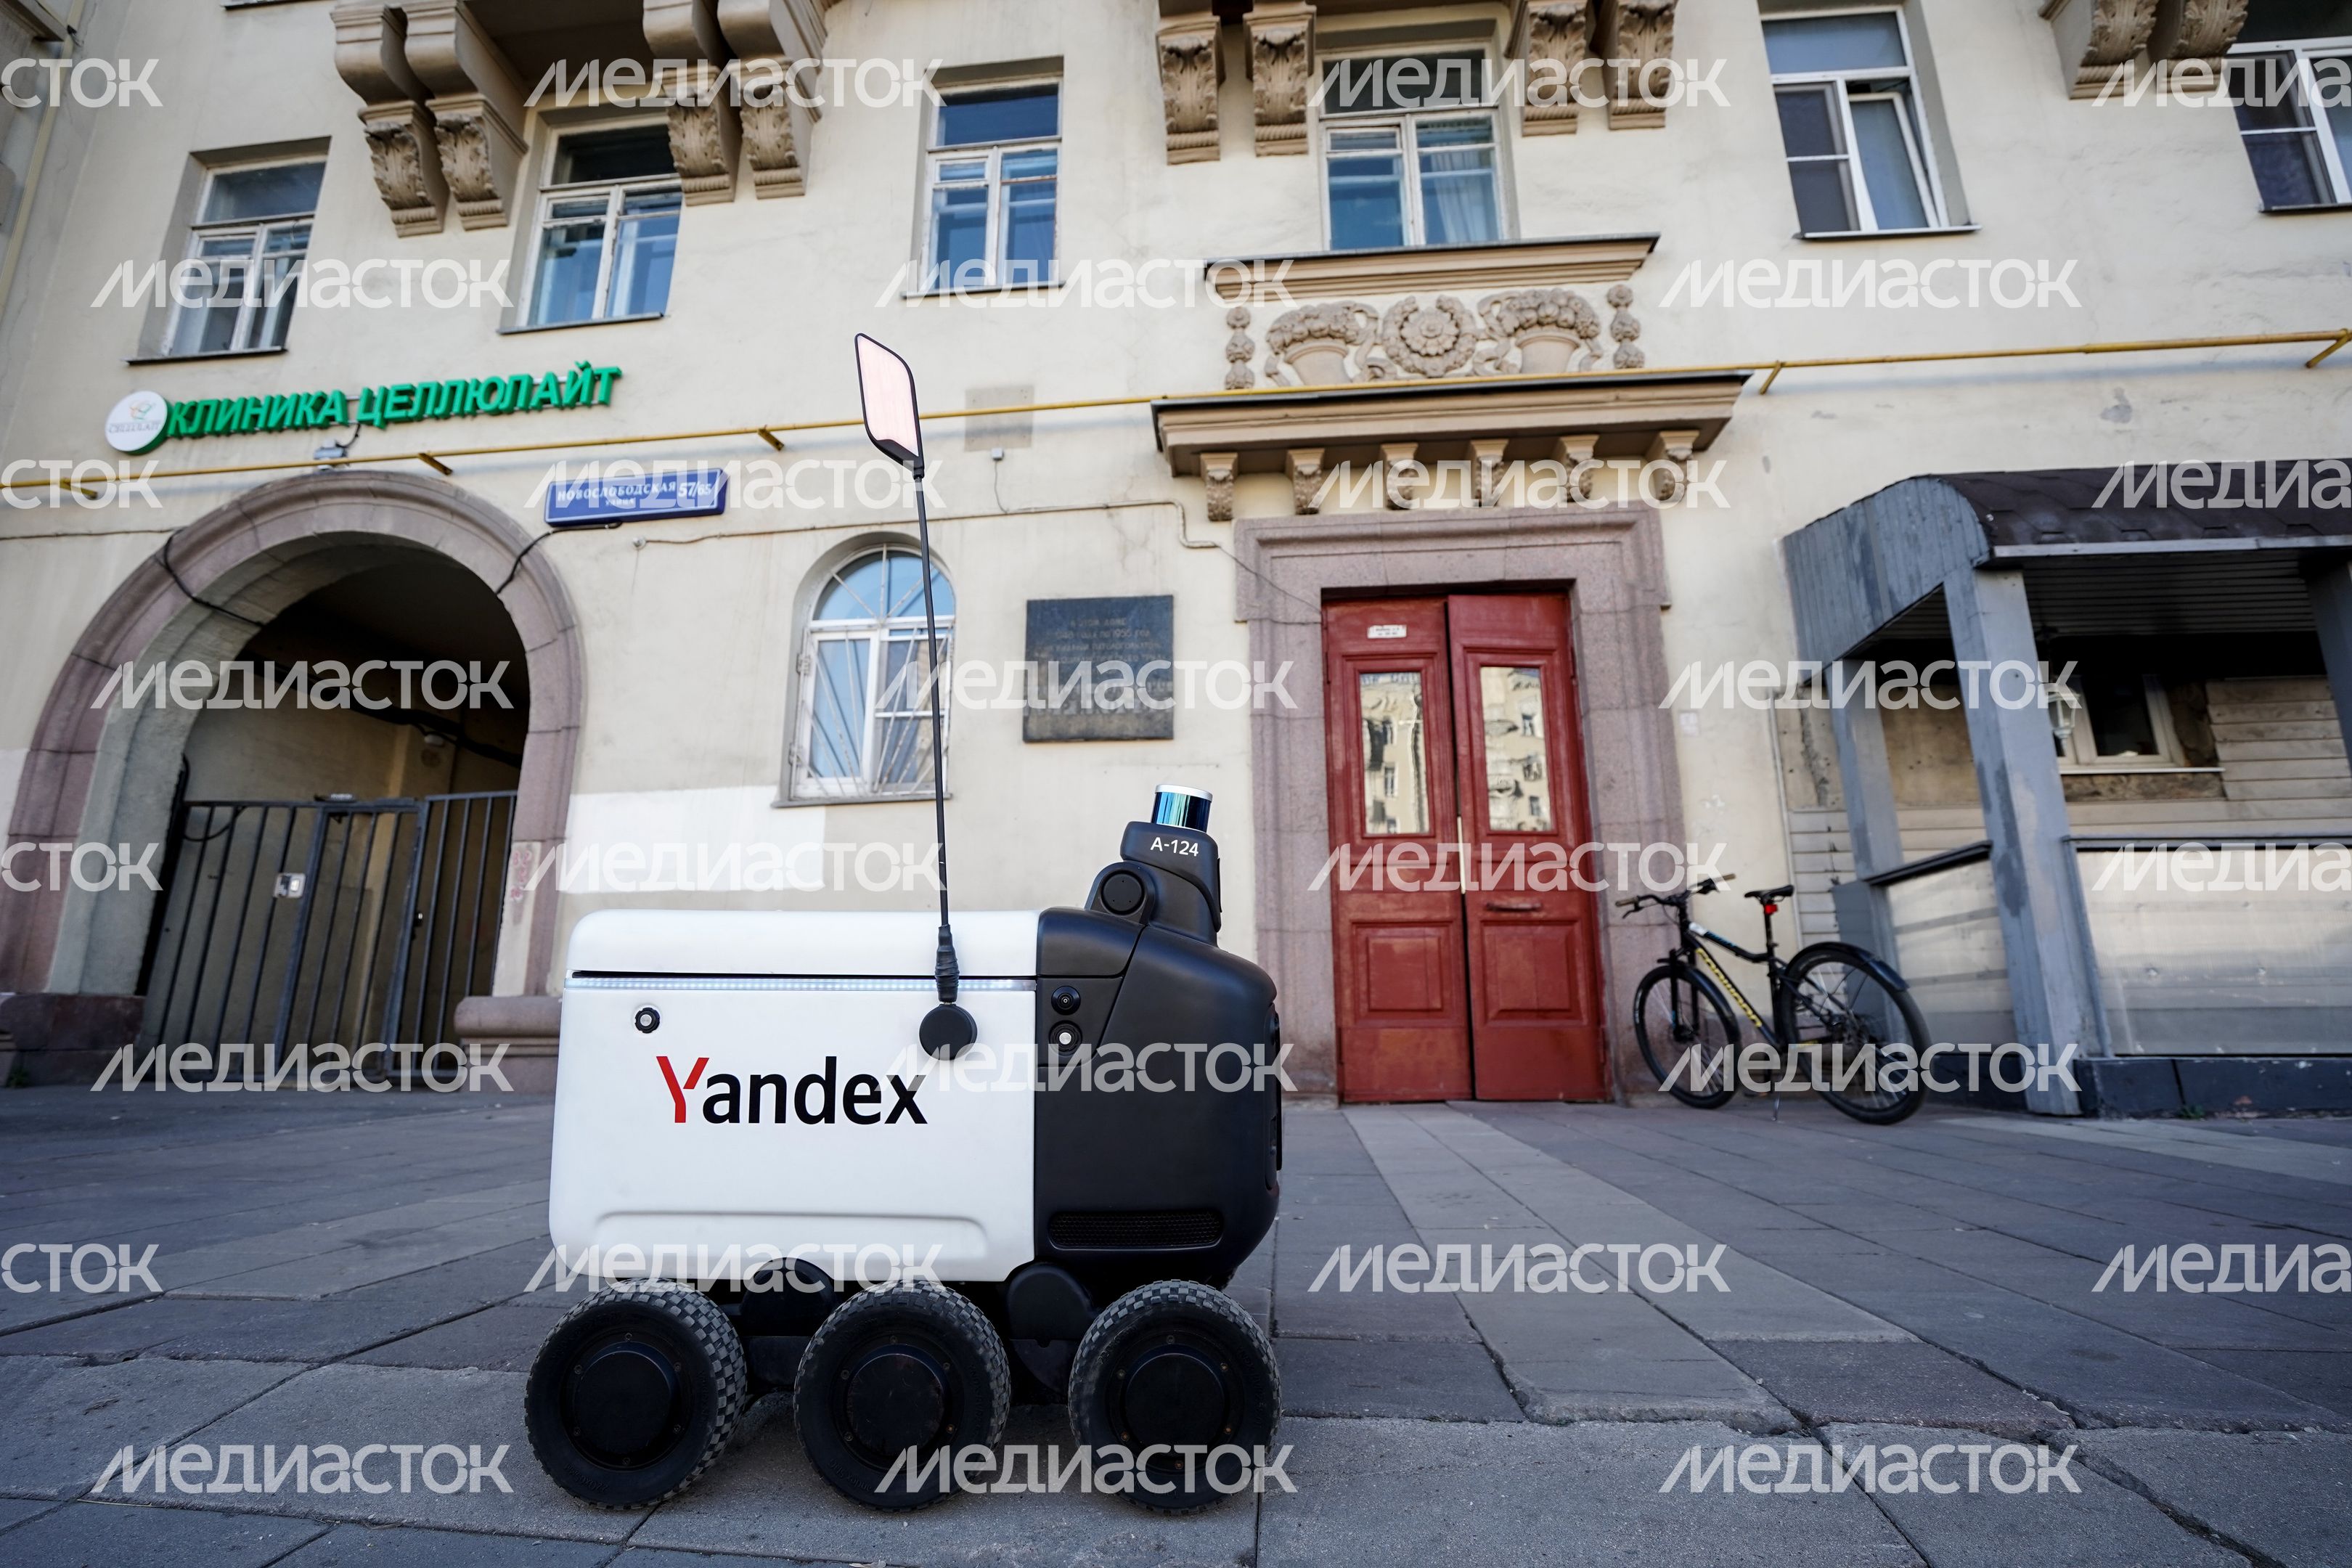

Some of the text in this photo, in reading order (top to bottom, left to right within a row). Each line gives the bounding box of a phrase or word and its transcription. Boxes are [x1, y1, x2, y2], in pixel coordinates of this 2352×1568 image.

[166, 360, 623, 439] КЛИНИКА ЦЕЛЛЮЛАЙТ
[557, 481, 677, 502] НОВОСЛОБОДСКАЯ
[1150, 836, 1199, 857] A-124
[656, 1055, 928, 1125] Yandex
